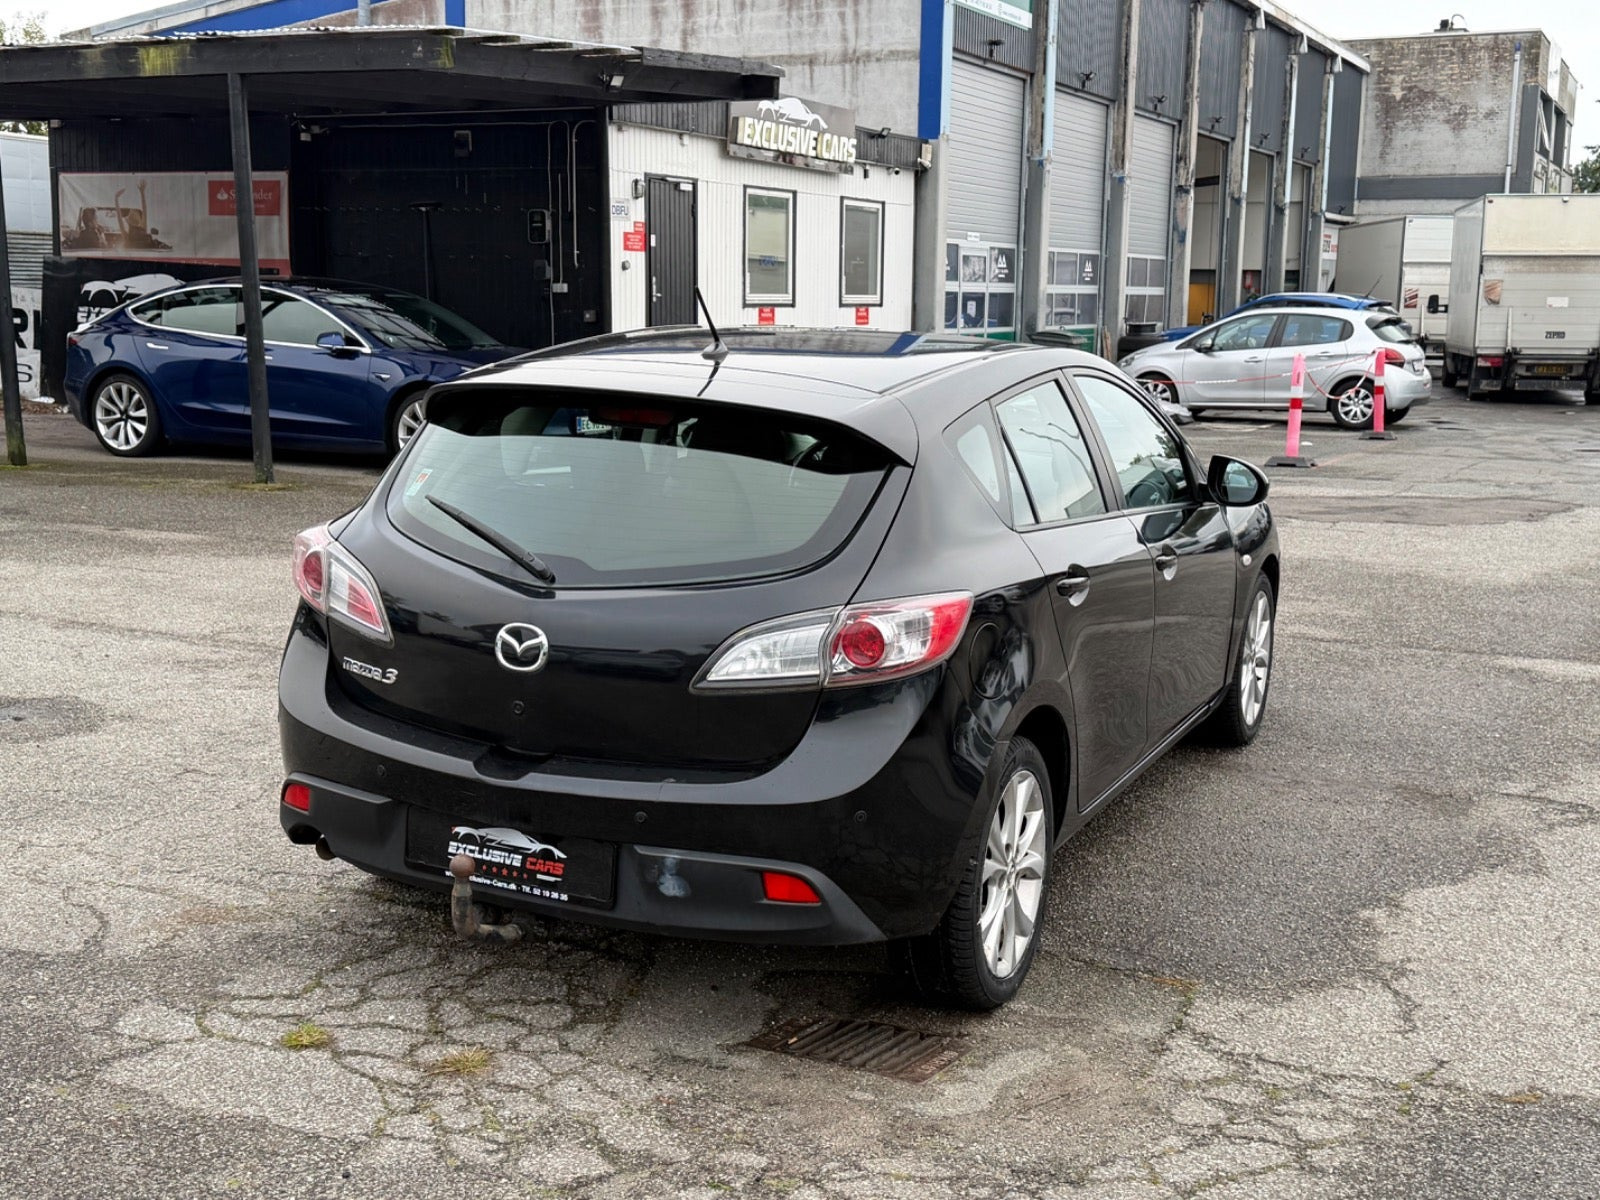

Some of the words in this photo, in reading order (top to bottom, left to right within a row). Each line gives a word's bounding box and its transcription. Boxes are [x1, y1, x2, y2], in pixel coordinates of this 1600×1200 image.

[741, 116, 819, 158] EXCLUSIVE
[820, 132, 858, 163] CARS
[1544, 331, 1566, 339] ZEPRO
[447, 841, 523, 867] EXCLUSIVE
[525, 857, 565, 876] CARS
